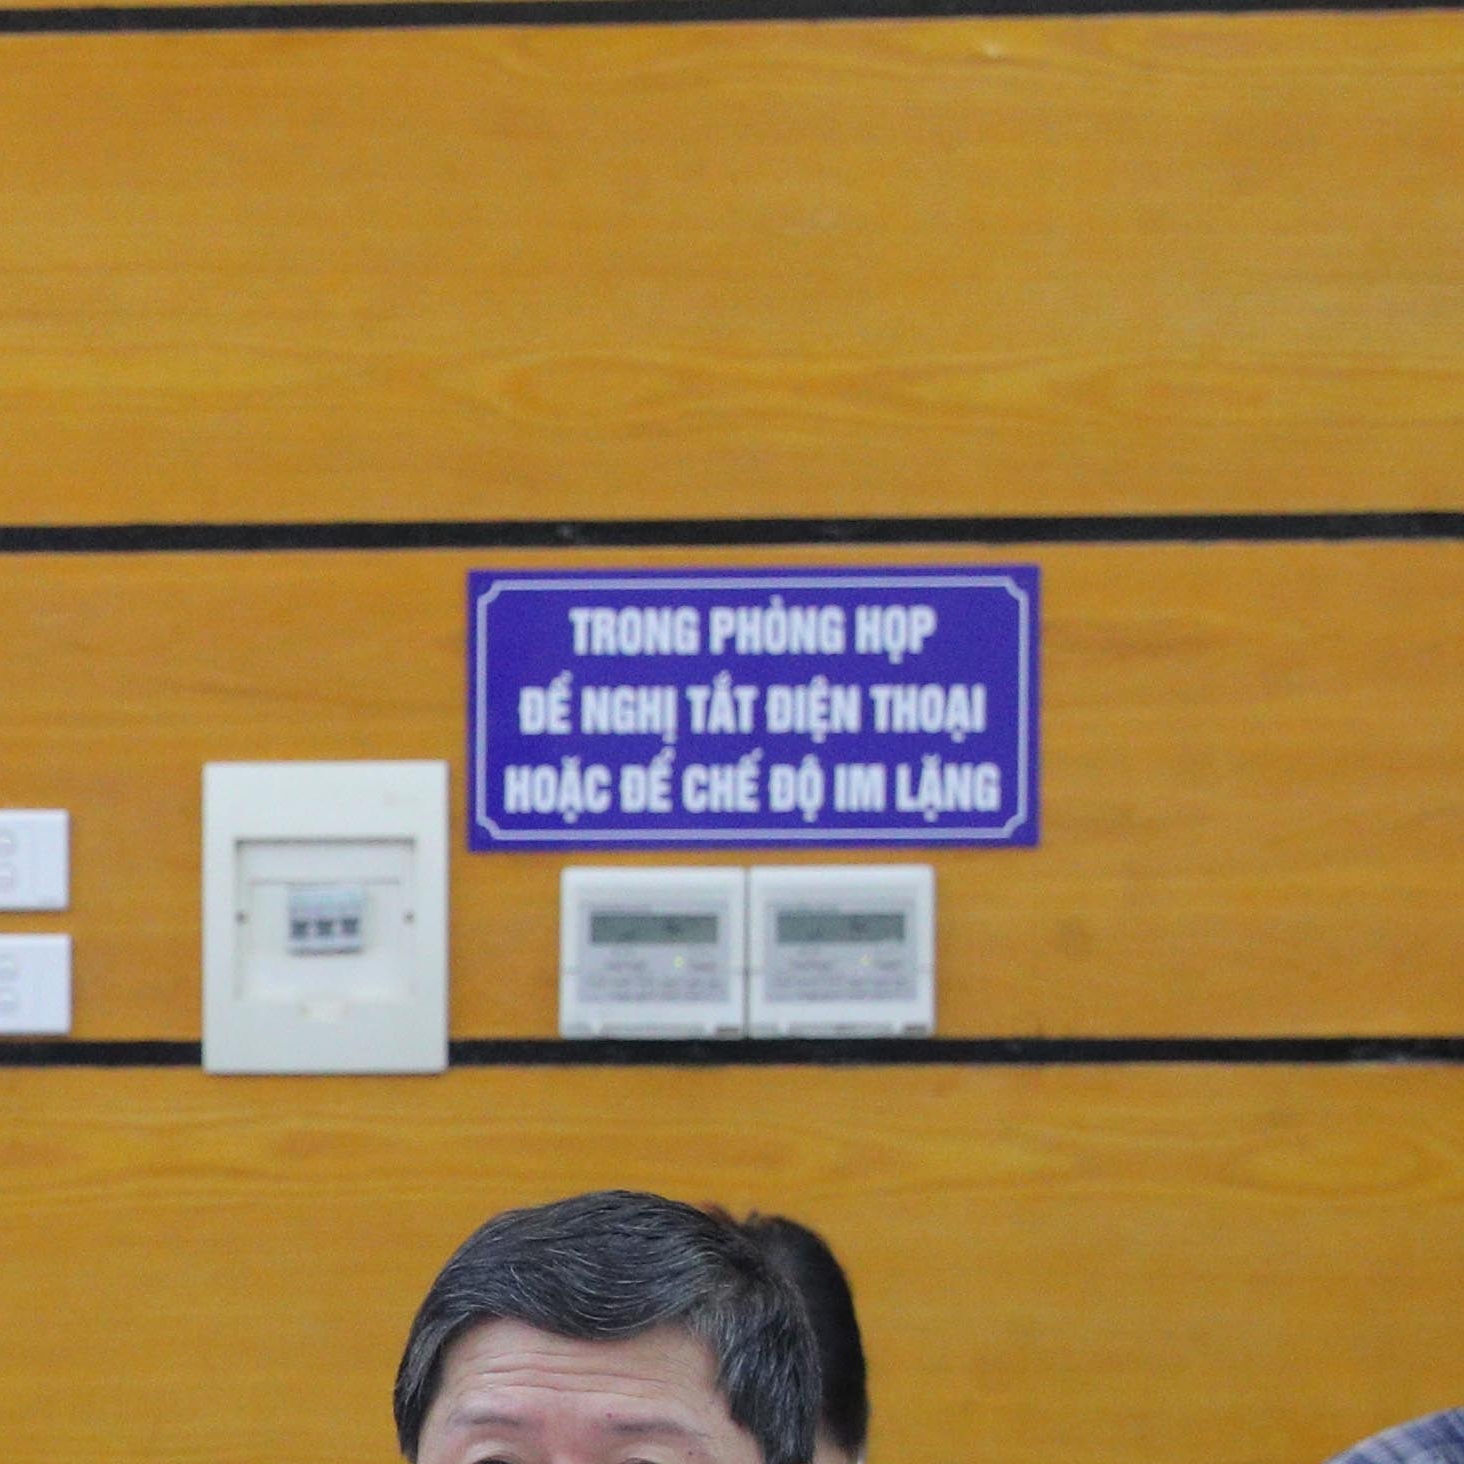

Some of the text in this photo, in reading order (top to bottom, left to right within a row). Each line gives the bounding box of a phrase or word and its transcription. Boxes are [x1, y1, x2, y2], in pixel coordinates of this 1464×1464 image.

[569, 594, 937, 665] TRONG PHÒNG HỌP
[581, 684, 678, 745] NGHỊ
[765, 673, 861, 744] ĐIỆN
[869, 683, 987, 744] THOẠI
[503, 755, 612, 824] HOẶC
[681, 746, 763, 813] CHẾ
[768, 753, 825, 823] ĐỘ
[833, 763, 886, 813] IM
[895, 752, 1002, 823] LẶNG
